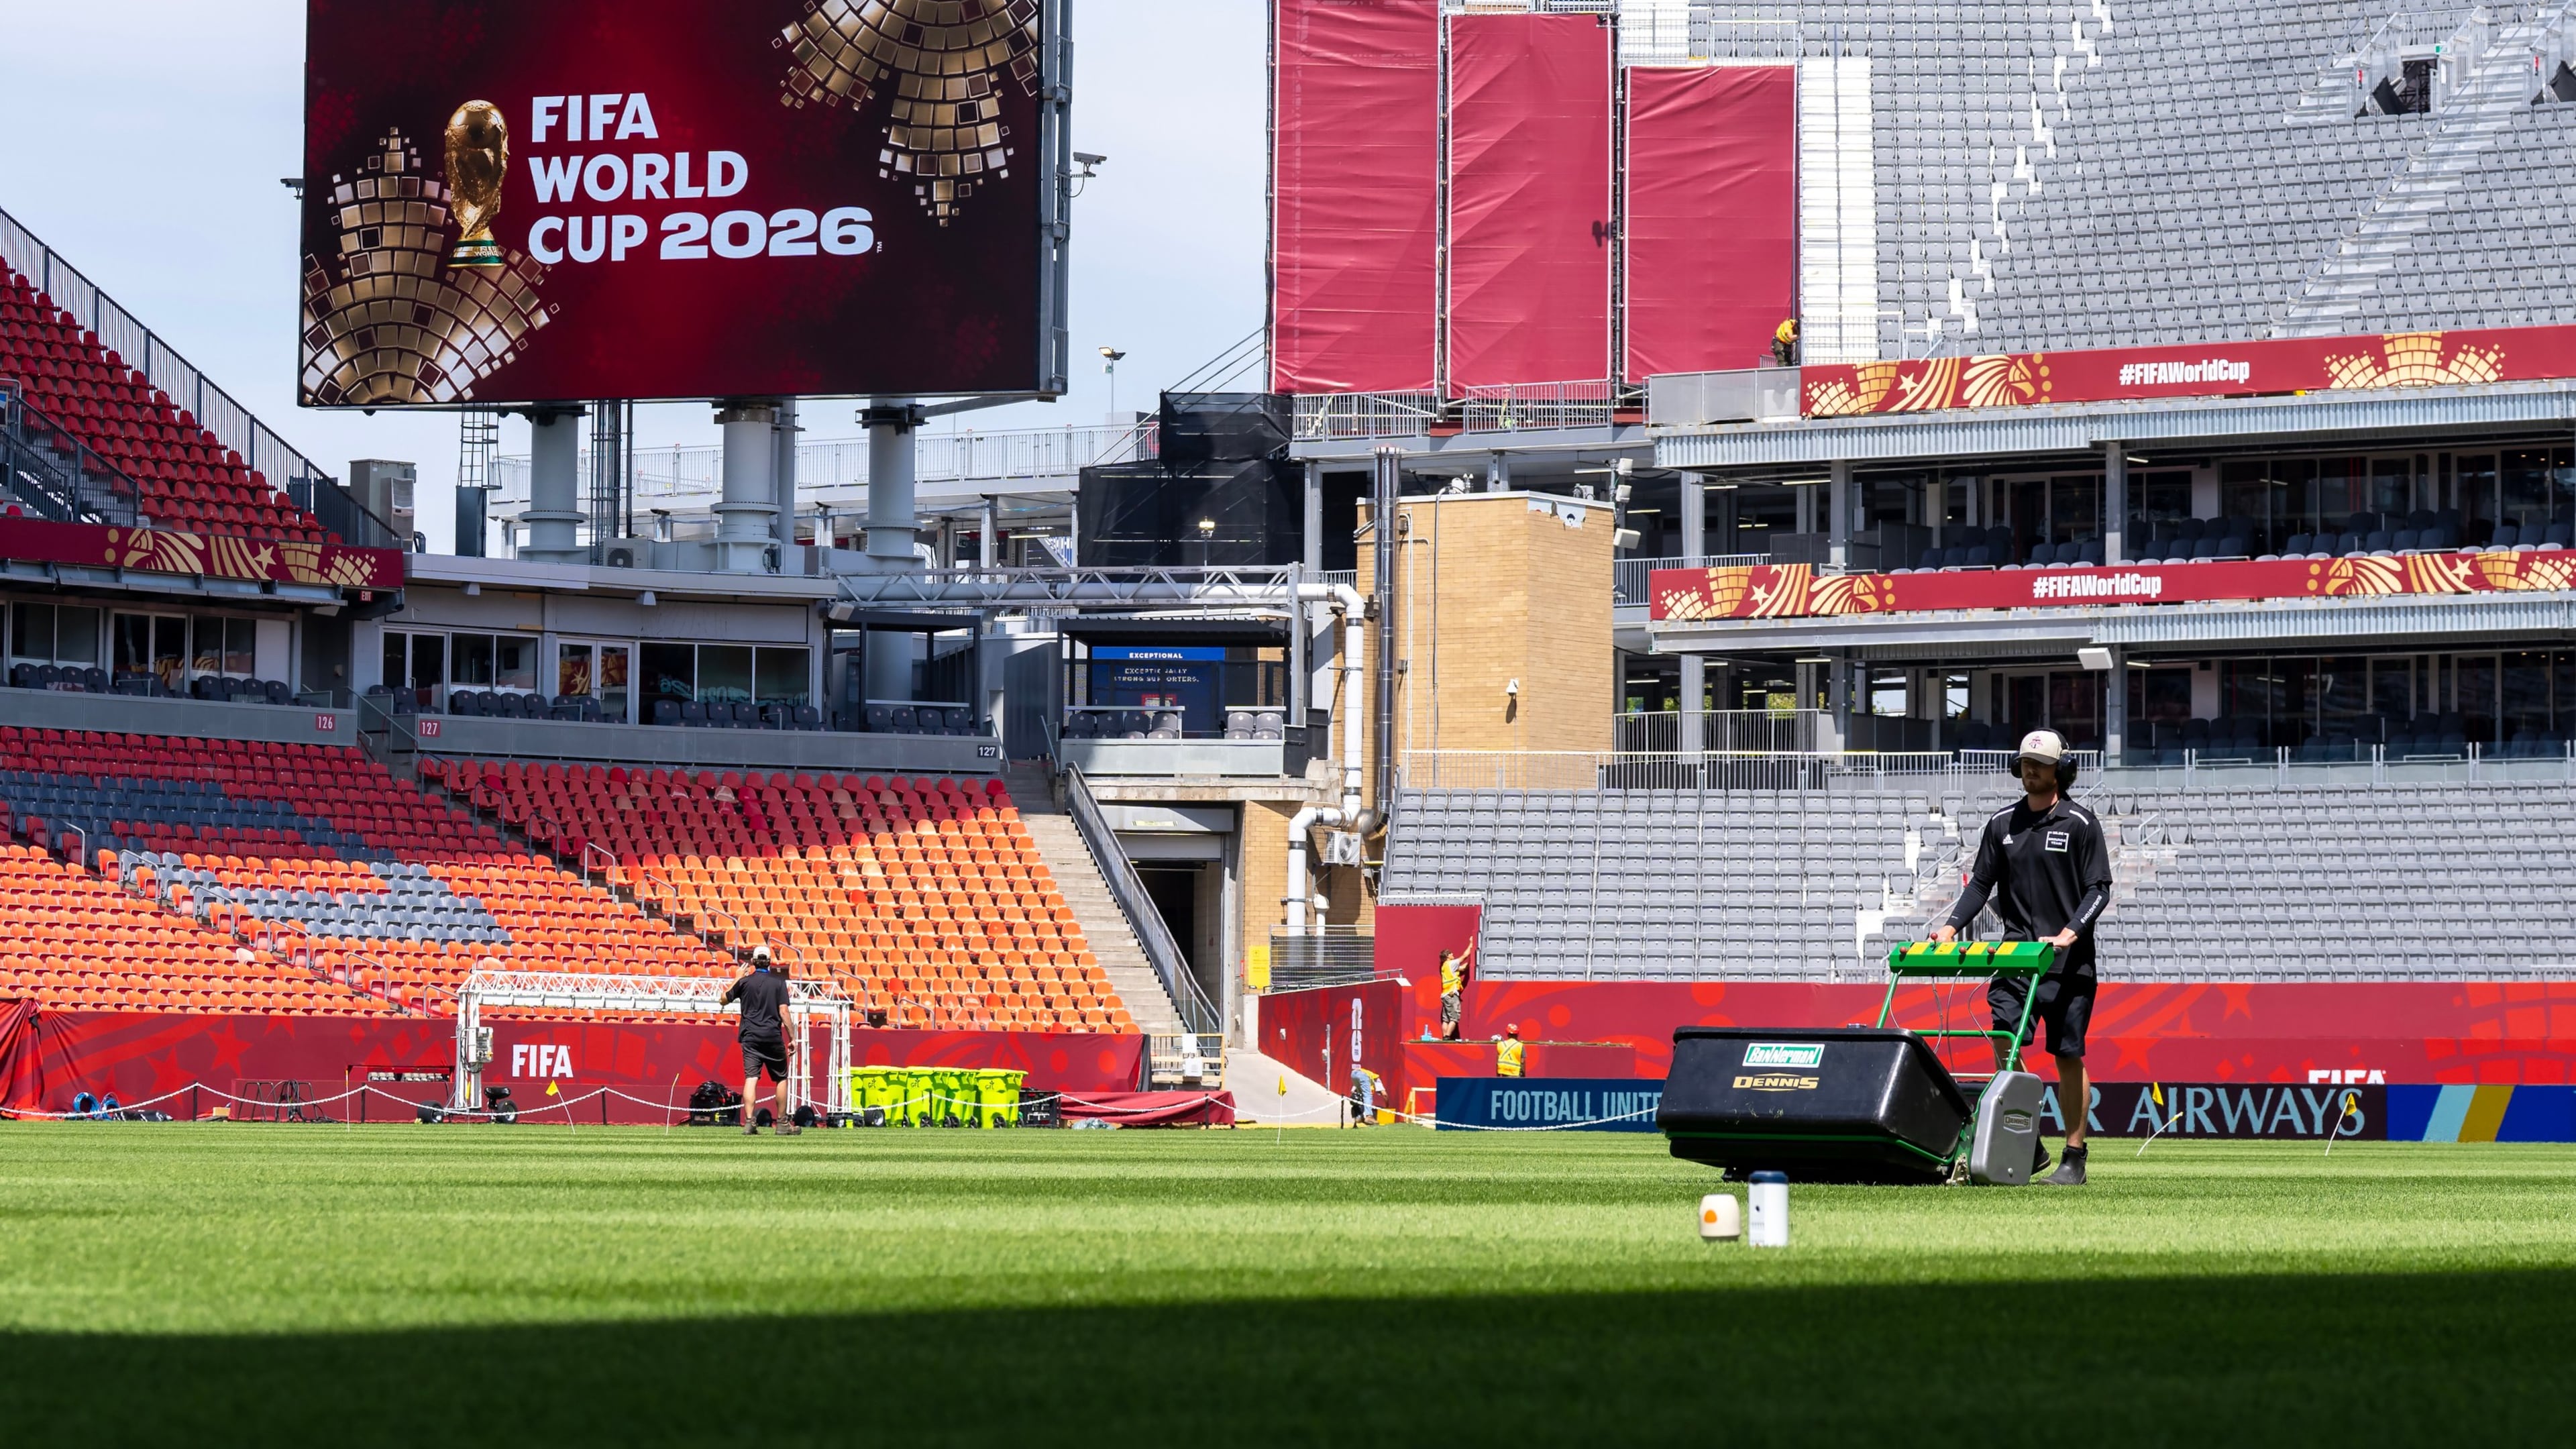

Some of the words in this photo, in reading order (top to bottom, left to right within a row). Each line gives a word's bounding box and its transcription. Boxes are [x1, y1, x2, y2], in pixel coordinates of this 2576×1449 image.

[531, 93, 659, 142] FIFA
[529, 150, 749, 203] WORLD
[528, 215, 648, 264] CUP
[659, 207, 874, 260] 2026
[2118, 358, 2250, 386] #FIFAWorldCup
[362, 590, 372, 601] EXIT
[2033, 573, 2162, 598] #FIFAWorldCup
[318, 716, 333, 729] 126
[422, 722, 438, 735] 127
[979, 746, 996, 757] 127
[512, 1044, 574, 1078] FIFA
[1732, 1075, 1820, 1090] DENNIS
[1491, 1090, 1597, 1121] FOOTBALL
[2127, 1086, 2365, 1136] AIRWAYS
